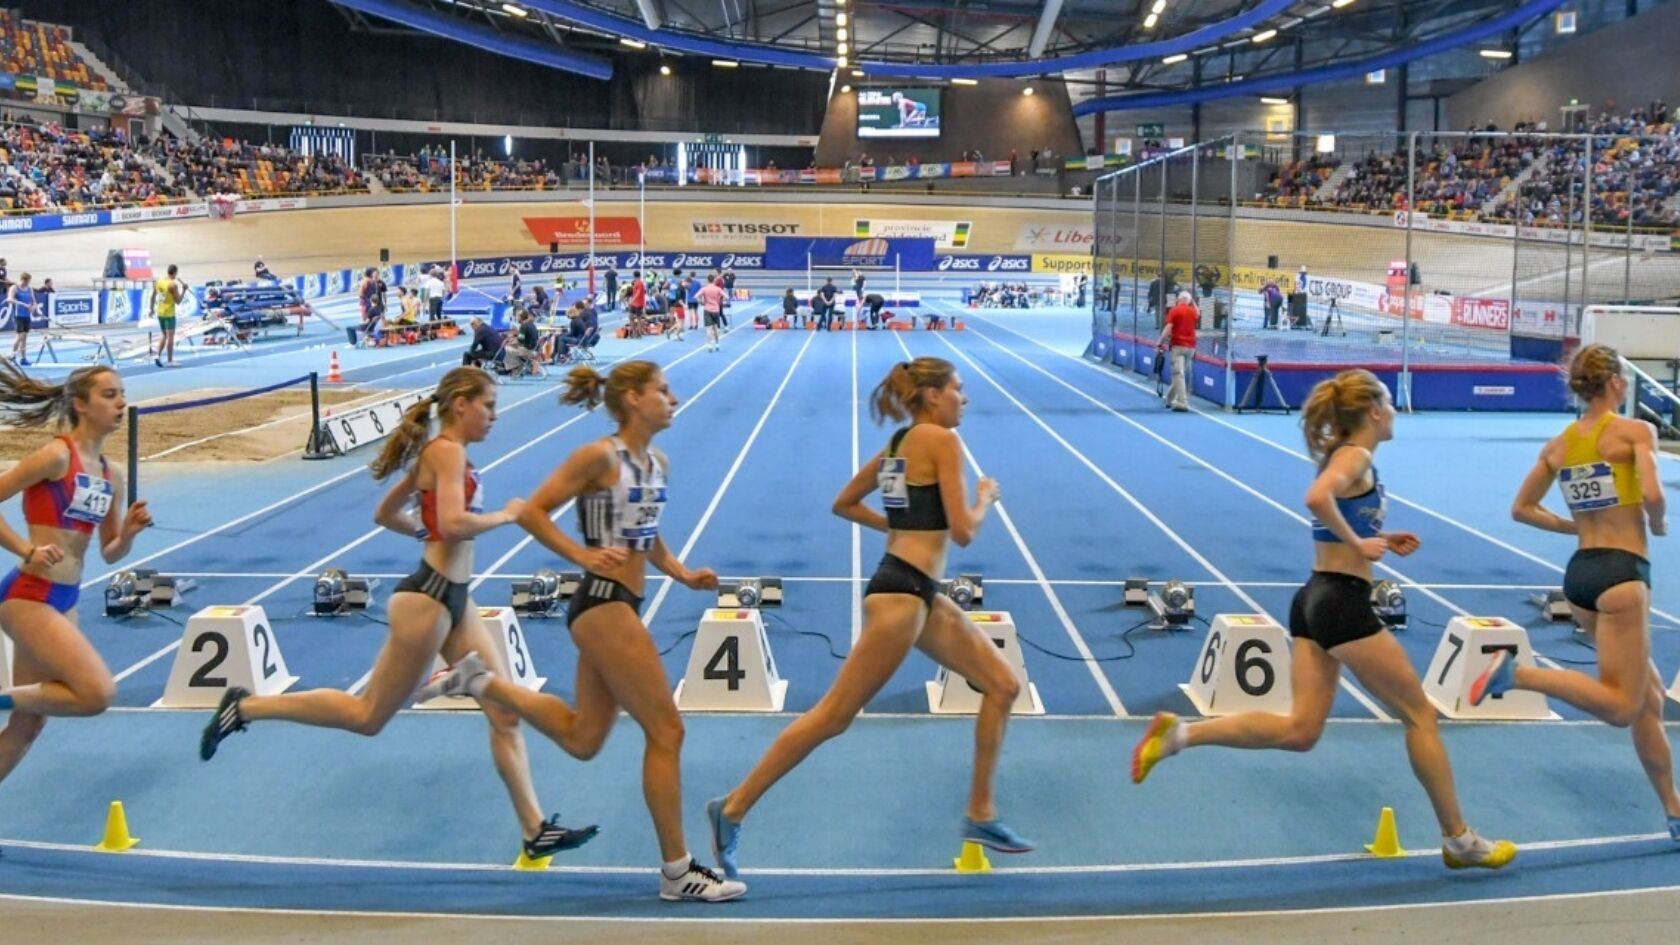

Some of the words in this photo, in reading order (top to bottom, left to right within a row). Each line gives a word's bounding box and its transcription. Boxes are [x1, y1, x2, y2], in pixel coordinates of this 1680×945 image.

[62, 213, 98, 227] SHIMANO
[722, 223, 799, 234] TISSOT
[57, 301, 90, 314] Sports
[1463, 303, 1508, 327] RUNNERS
[341, 419, 356, 444] 9
[369, 410, 384, 434] 8
[83, 493, 107, 513] 413
[1570, 481, 1601, 500] 329
[188, 631, 229, 687] 2
[253, 623, 277, 680] 2
[508, 624, 526, 678] 3
[703, 636, 745, 691] 4
[1201, 631, 1221, 684] 6
[1235, 638, 1275, 696] 6
[1438, 633, 1464, 685] 7
